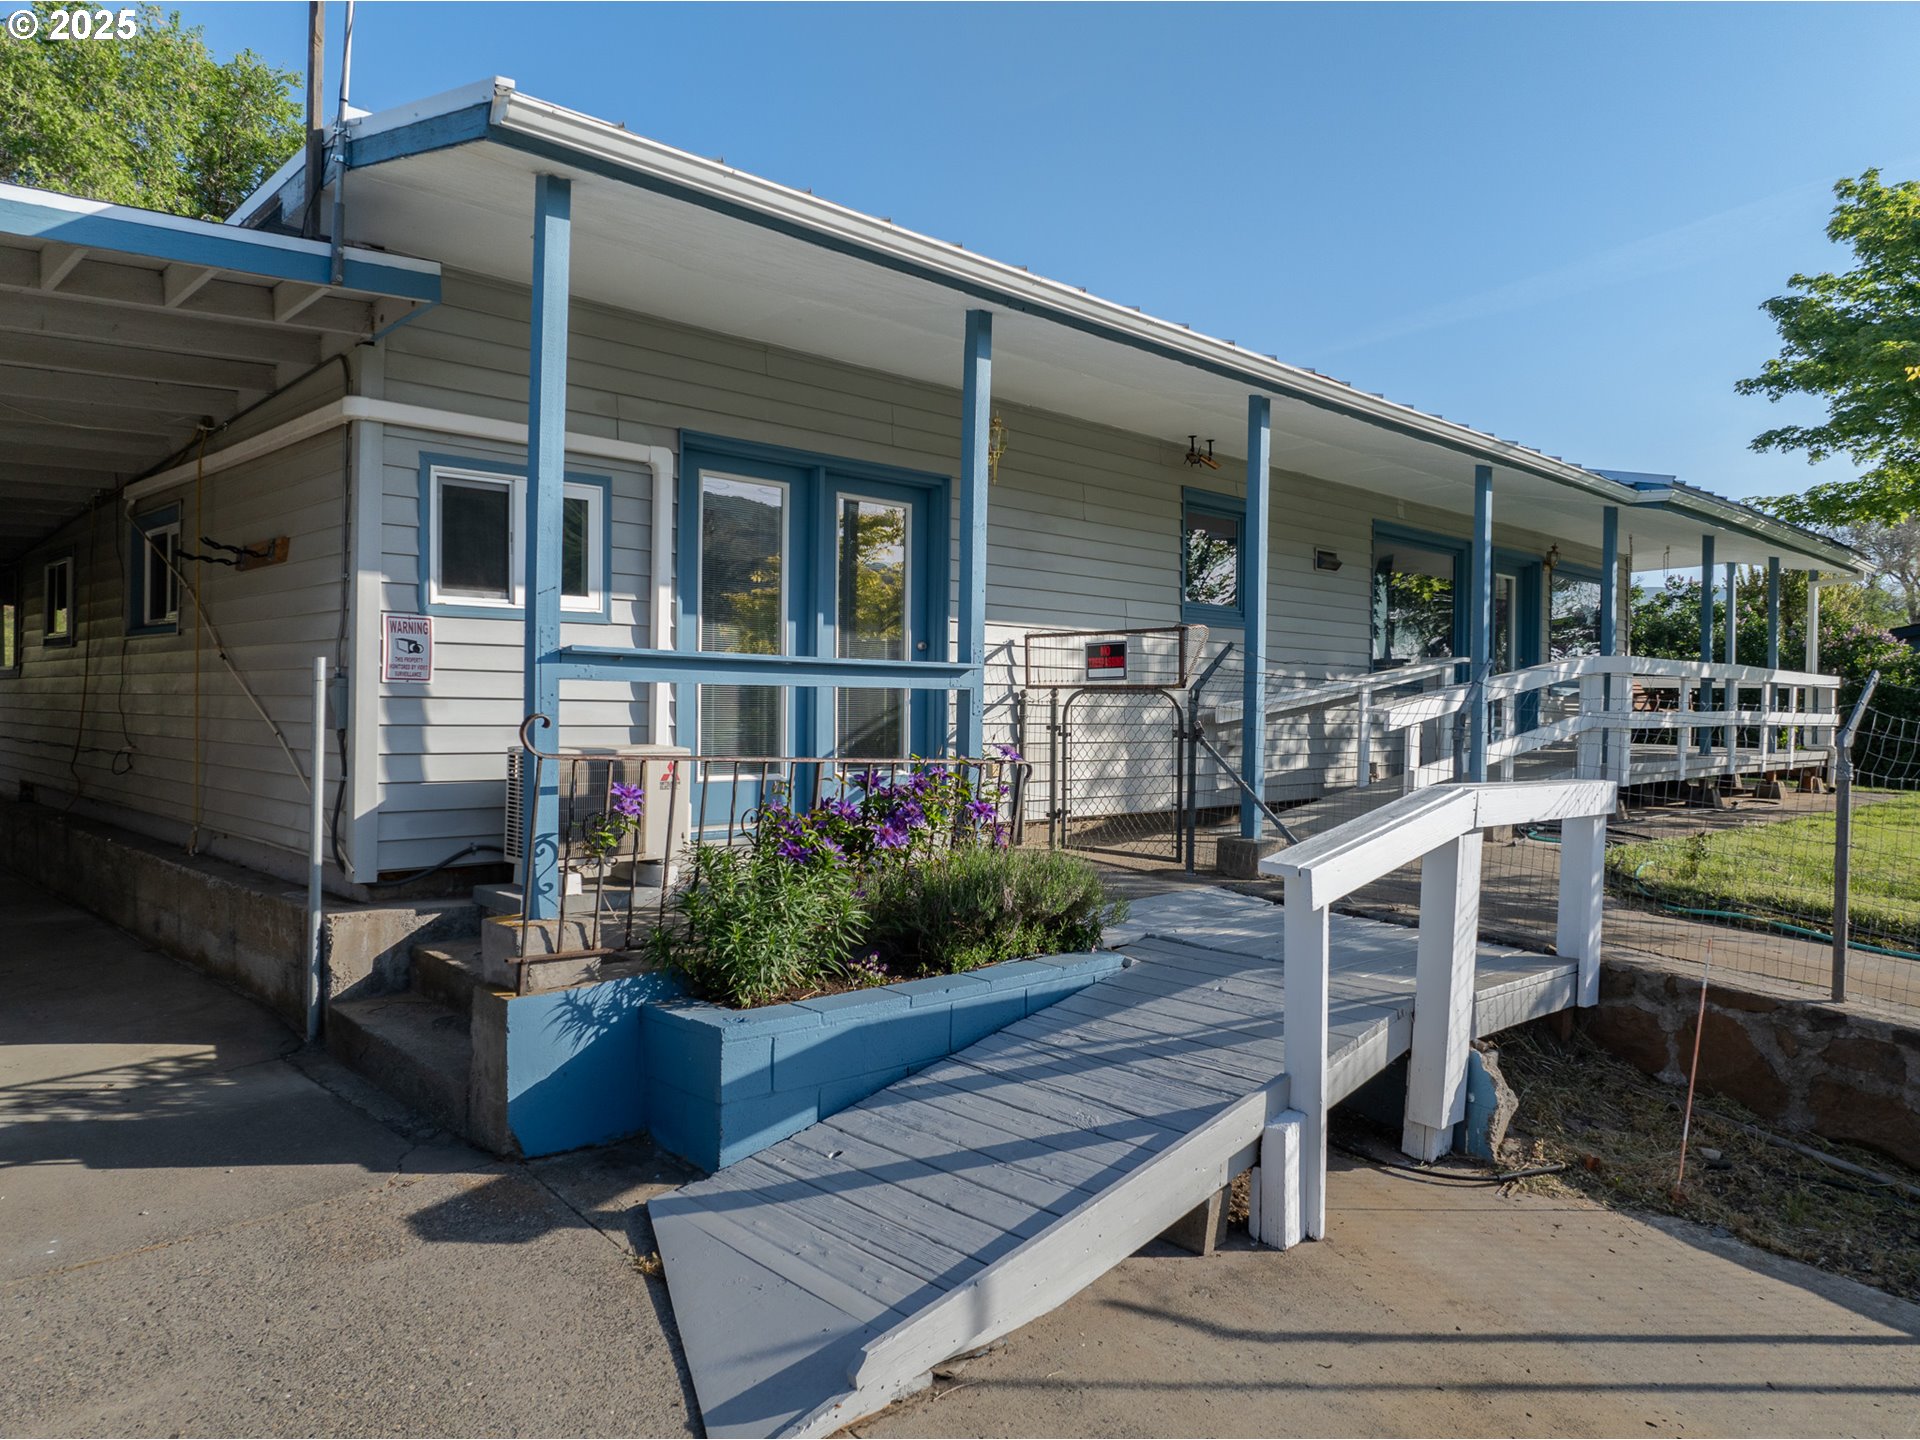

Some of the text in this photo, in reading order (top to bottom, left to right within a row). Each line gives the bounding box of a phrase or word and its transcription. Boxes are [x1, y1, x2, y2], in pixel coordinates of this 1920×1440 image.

[389, 620, 428, 635] WARNING
[1100, 646, 1110, 656] NO
[1088, 656, 1124, 668] TRESPASSING
